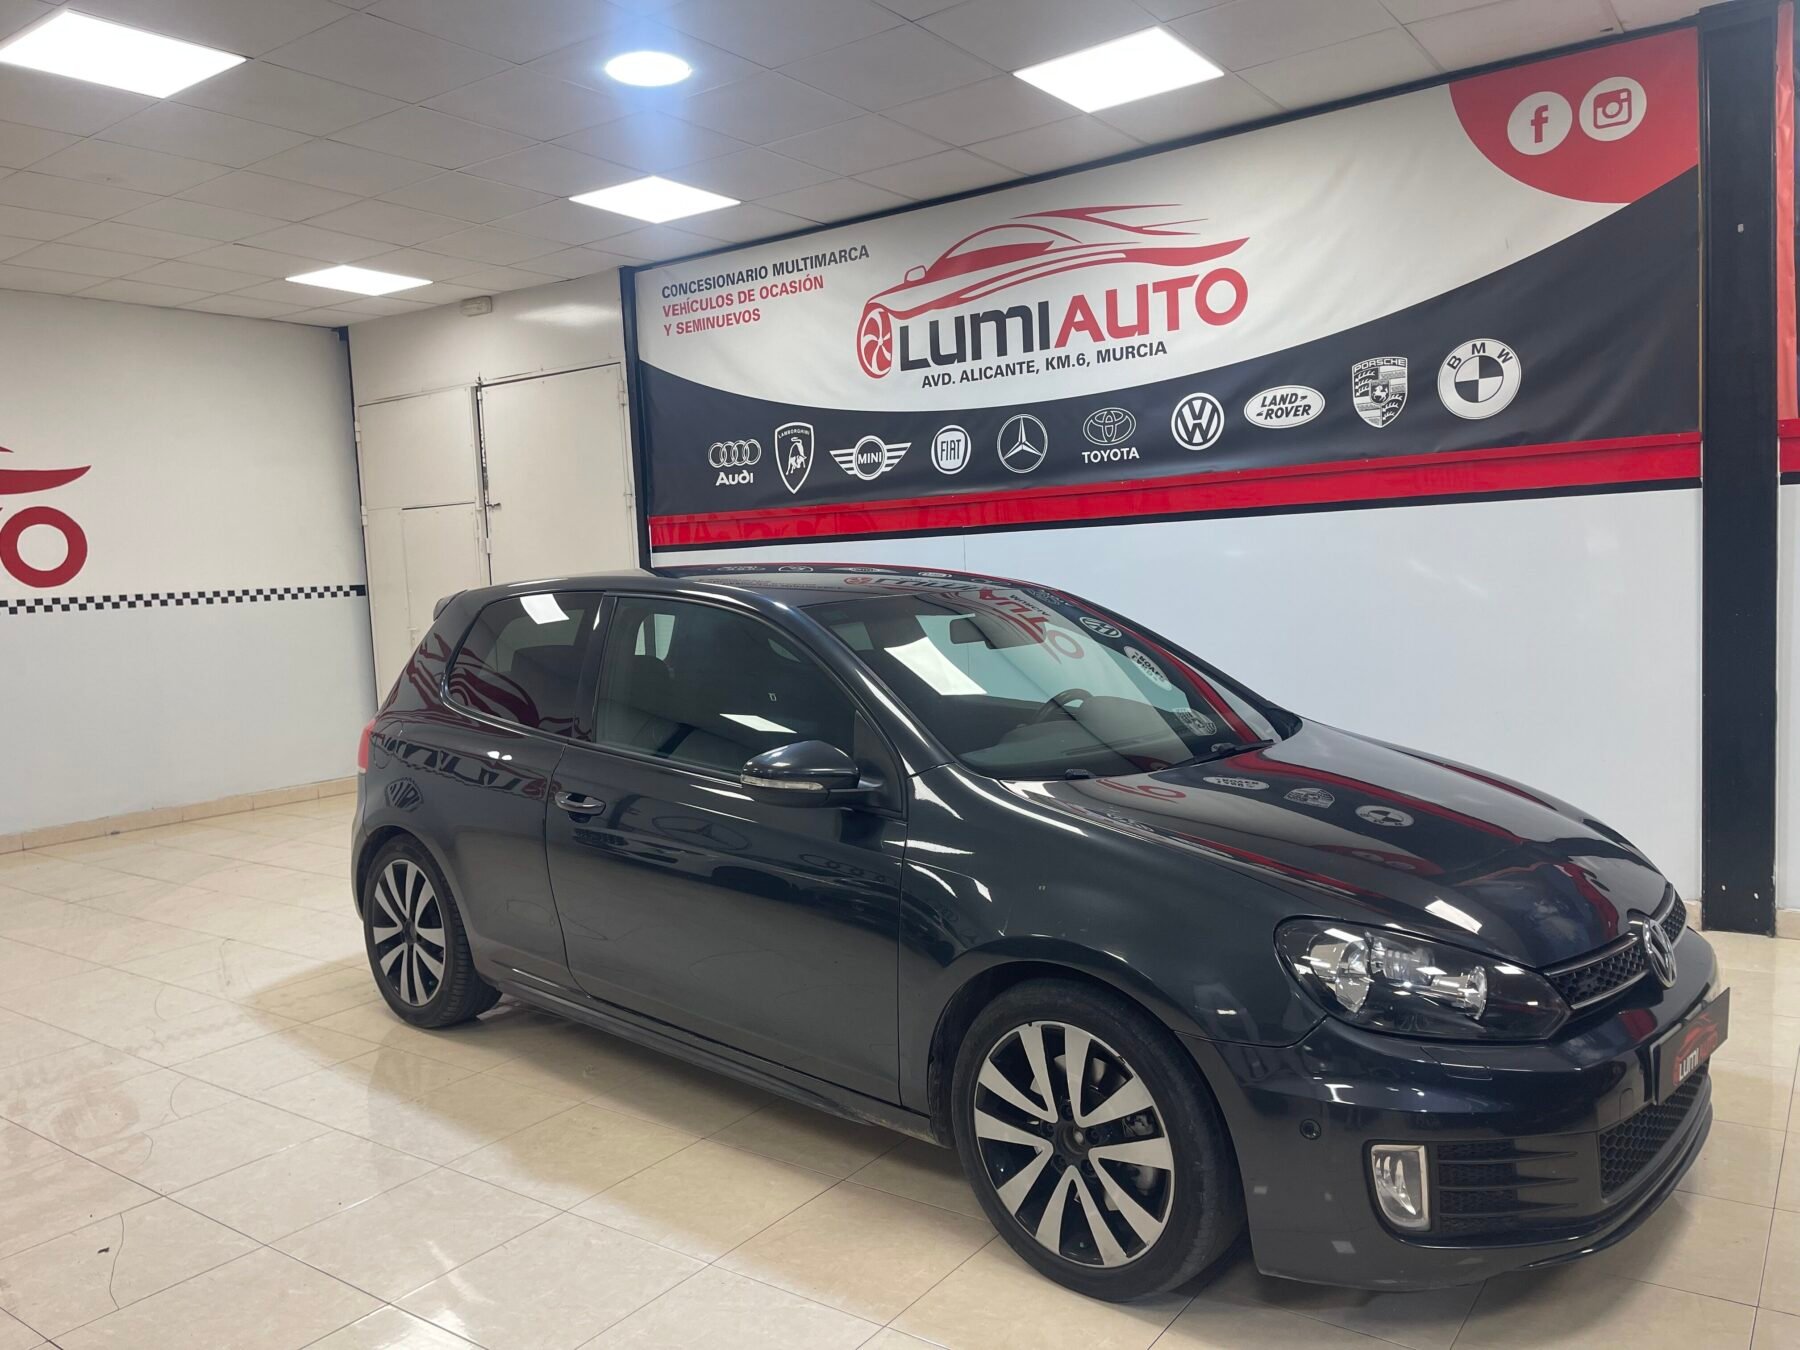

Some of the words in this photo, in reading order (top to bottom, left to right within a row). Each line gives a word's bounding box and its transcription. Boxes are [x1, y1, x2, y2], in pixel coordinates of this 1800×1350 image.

[661, 265, 768, 299] CONCESIONARIO
[772, 244, 870, 277] MULTIMARCA
[662, 293, 734, 318] VEHÍCULOS
[738, 289, 755, 305] DE
[759, 273, 824, 299] OCASIÓN
[664, 324, 672, 337] Y
[676, 308, 761, 335] SEMINUEVOS
[921, 374, 956, 389] AVD.
[959, 359, 1040, 384] ALICANTE,
[1045, 352, 1091, 372] KM.6,
[1096, 340, 1168, 364] MURCIA
[1353, 357, 1407, 374] PORSCHE
[1446, 342, 1513, 371] BMW
[857, 452, 882, 465] MINI
[940, 438, 961, 462] FIAT
[1081, 447, 1140, 464] TOYOTA
[715, 469, 754, 486] Audi
